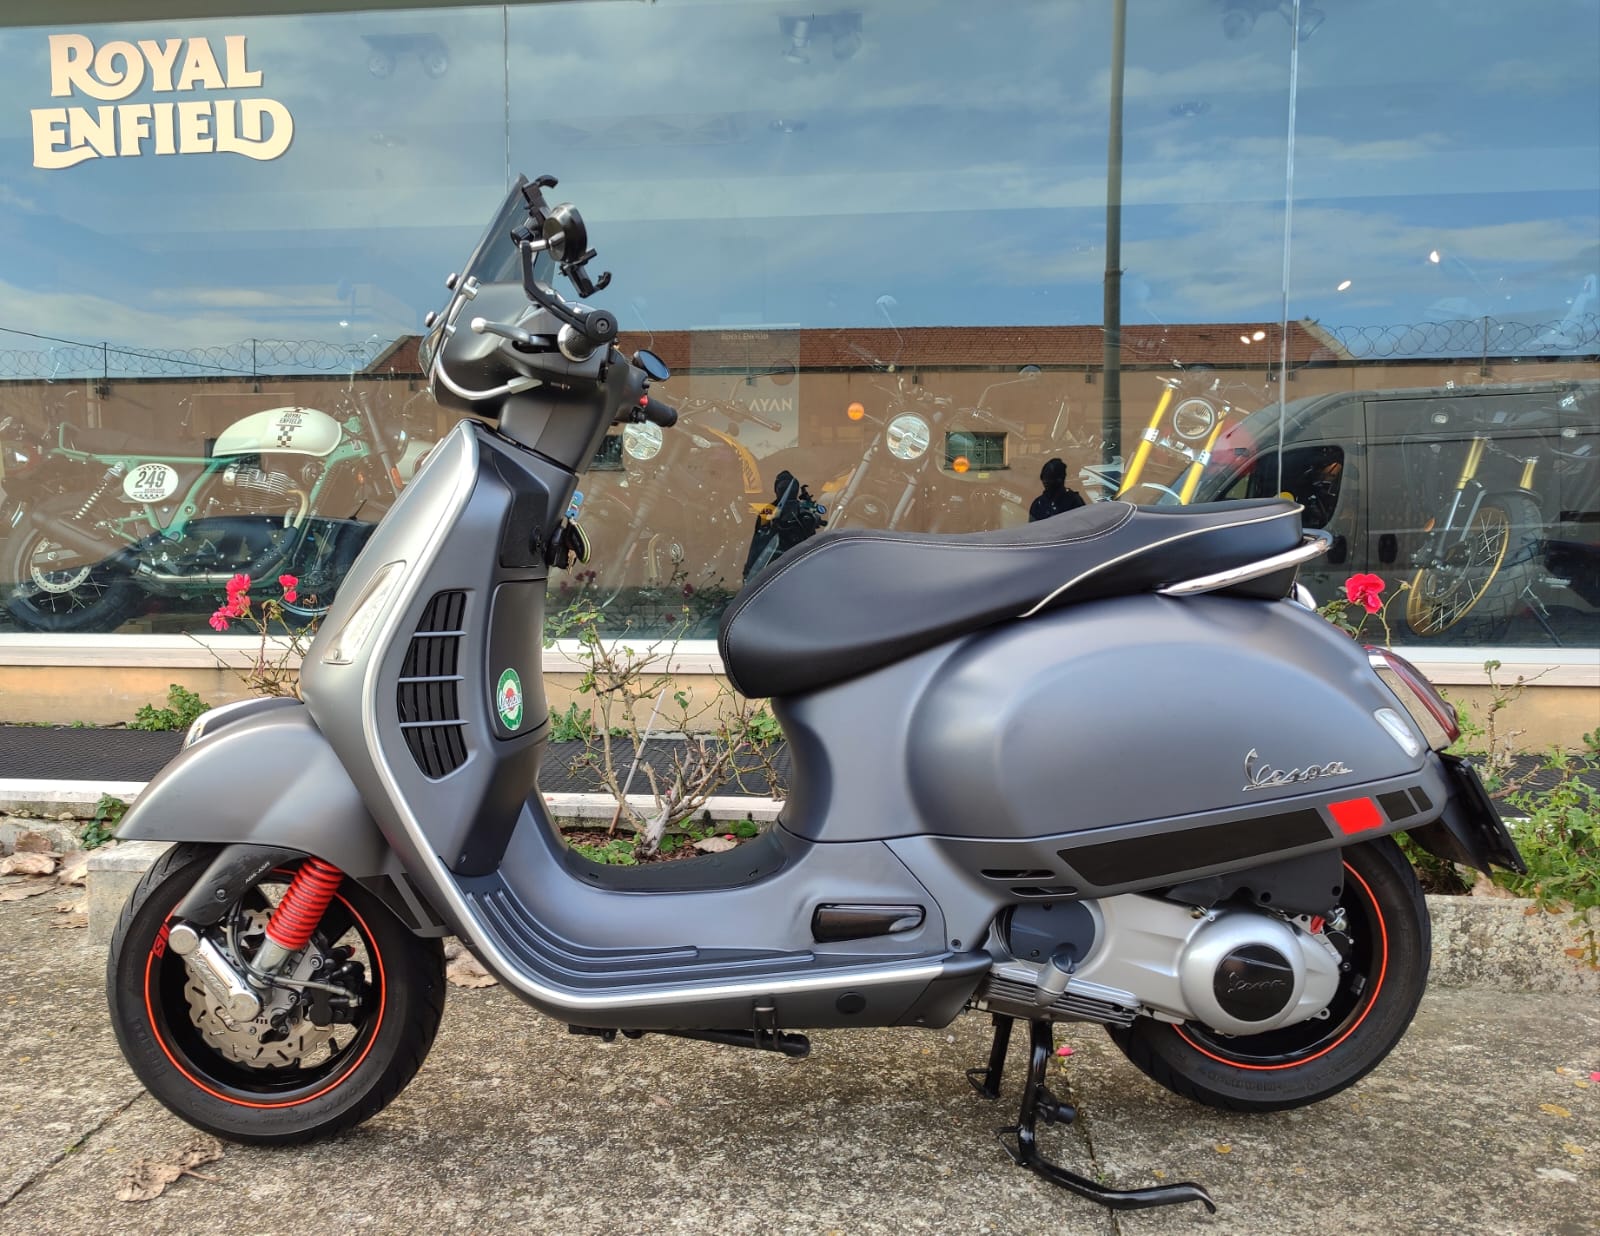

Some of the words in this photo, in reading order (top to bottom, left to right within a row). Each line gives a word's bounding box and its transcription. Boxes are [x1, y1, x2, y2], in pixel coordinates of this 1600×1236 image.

[48, 33, 263, 101] ROYAL
[30, 98, 295, 169] ENFIELD
[134, 470, 167, 489] 249
[1242, 747, 1353, 792] Vespa
[1227, 970, 1287, 993] Vespa
